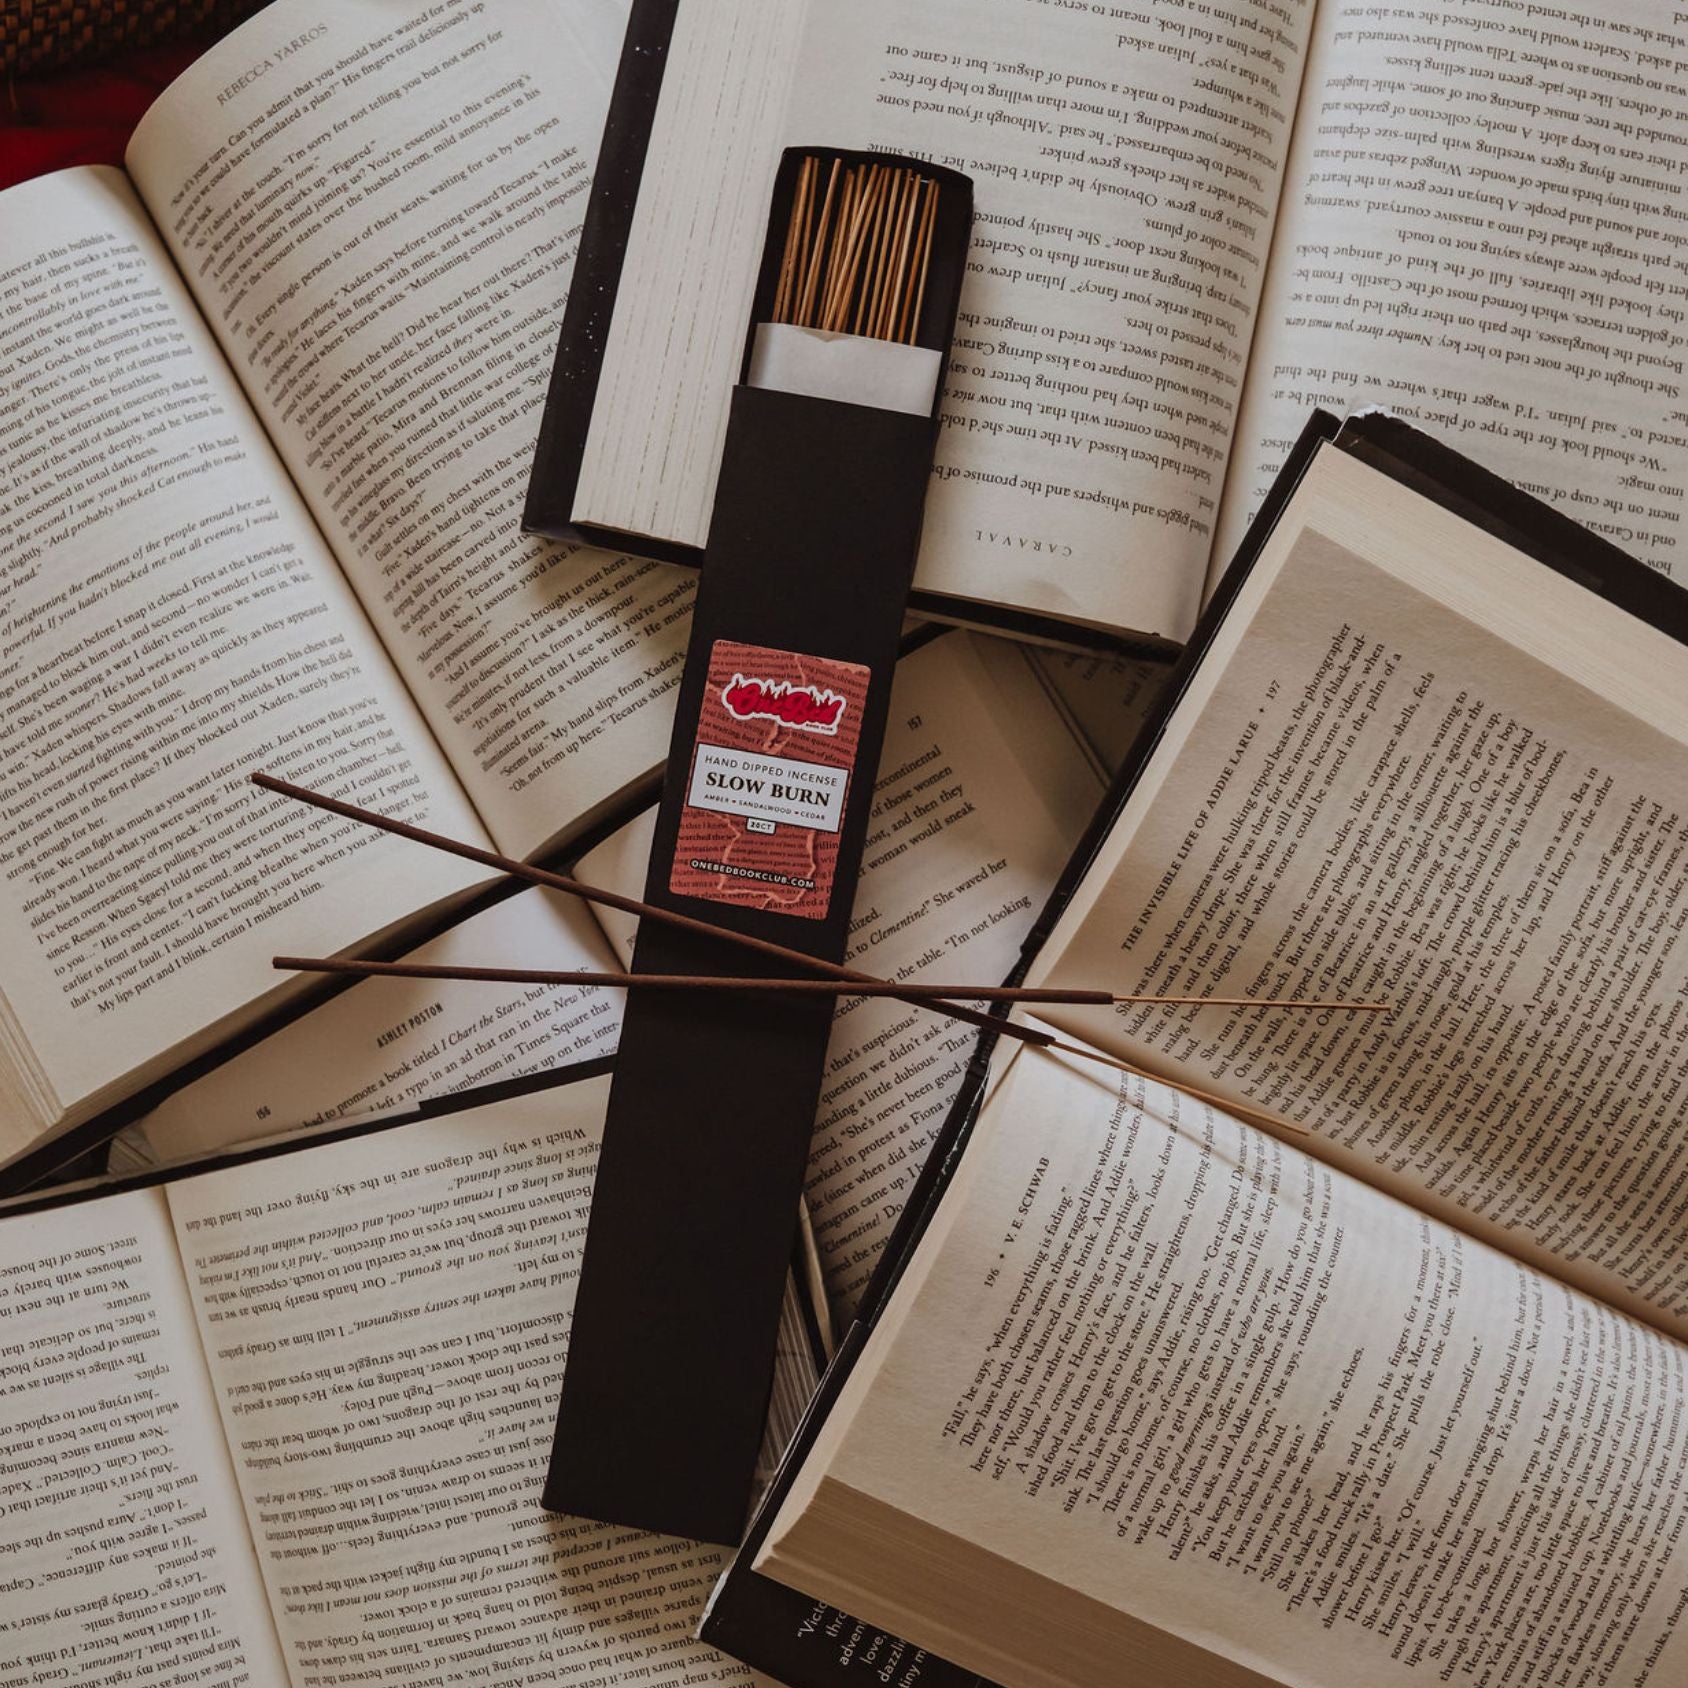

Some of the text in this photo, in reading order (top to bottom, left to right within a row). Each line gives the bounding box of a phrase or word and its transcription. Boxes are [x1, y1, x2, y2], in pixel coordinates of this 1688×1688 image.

[216, 23, 328, 106] REBECCA YARROS
[876, 93, 911, 108] some
[912, 101, 944, 114] need
[947, 105, 970, 118] you
[969, 112, 983, 124] if
[1088, 130, 1105, 146] he
[1195, 156, 1211, 172] be
[1211, 161, 1224, 173] to
[1224, 166, 1248, 181] need
[1438, 237, 1452, 248] to
[1455, 240, 1478, 252] not
[1480, 242, 1521, 260] saying
[1524, 253, 1566, 273] always
[1567, 263, 1597, 277] were
[1600, 269, 1642, 286] people
[1644, 279, 1666, 296] felt
[976, 530, 1072, 557] CARAVAL
[907, 715, 922, 731] 157
[527, 765, 544, 782] not
[541, 750, 566, 771] from
[565, 740, 580, 754] up
[606, 696, 649, 724] Tecarus
[704, 755, 839, 788] HAND DIPPED INCENSE
[705, 771, 832, 808] SLOW BURN
[866, 766, 953, 818] of those women
[704, 793, 827, 822] AMBER SANDALWOOD CEDAR
[891, 811, 913, 832] and
[912, 799, 939, 818] then
[939, 784, 963, 803] they
[1120, 679, 1281, 951] THE INVISIBLE LIFE OF ADDIE LARUE 197
[750, 820, 773, 832] 20CT
[868, 843, 908, 869] woman
[908, 818, 943, 845] would
[944, 801, 976, 826] sneak
[6, 858, 38, 881] strong
[36, 836, 72, 863] enough
[71, 827, 88, 842] for
[690, 858, 815, 890] ONEBEDBOOKCLUB.COM
[1199, 672, 1435, 1062] She runs he fingers across the camera bodies, like carapace shells, feels
[855, 858, 1007, 954] to Clementine!” She waved her
[896, 965, 916, 981] the
[915, 948, 946, 969] table.
[970, 920, 990, 937] not
[987, 896, 1032, 925] looking
[97, 999, 115, 1014] My
[114, 989, 135, 1004] lips
[134, 975, 156, 995] part
[155, 962, 175, 980] and
[210, 924, 246, 948] certain
[253, 891, 300, 924] misheard
[376, 1002, 444, 1048] ASHLEY POSTON
[861, 1007, 919, 1053] suspicious.”
[324, 1108, 337, 1120] to
[336, 1084, 378, 1116] promote
[383, 1061, 413, 1083] book
[412, 1043, 440, 1067] titled
[448, 1023, 477, 1046] Chart
[479, 1014, 494, 1029] the
[523, 981, 546, 1002] but
[983, 1157, 1050, 1288] 196 V. E. SCHWAB
[942, 1186, 1072, 1437] “Fall,” he says, “when everything is fading.”
[60, 1445, 91, 1461] since
[94, 1433, 136, 1452] mantra
[1207, 1424, 1289, 1561] But he catches her hand.
[560, 1566, 581, 1578] the
[582, 1555, 626, 1576] around
[455, 1584, 503, 1603] remains
[505, 1572, 558, 1594] withered
[397, 1602, 428, 1618] clock
[440, 1596, 454, 1610] of
[839, 1620, 867, 1666] adven
